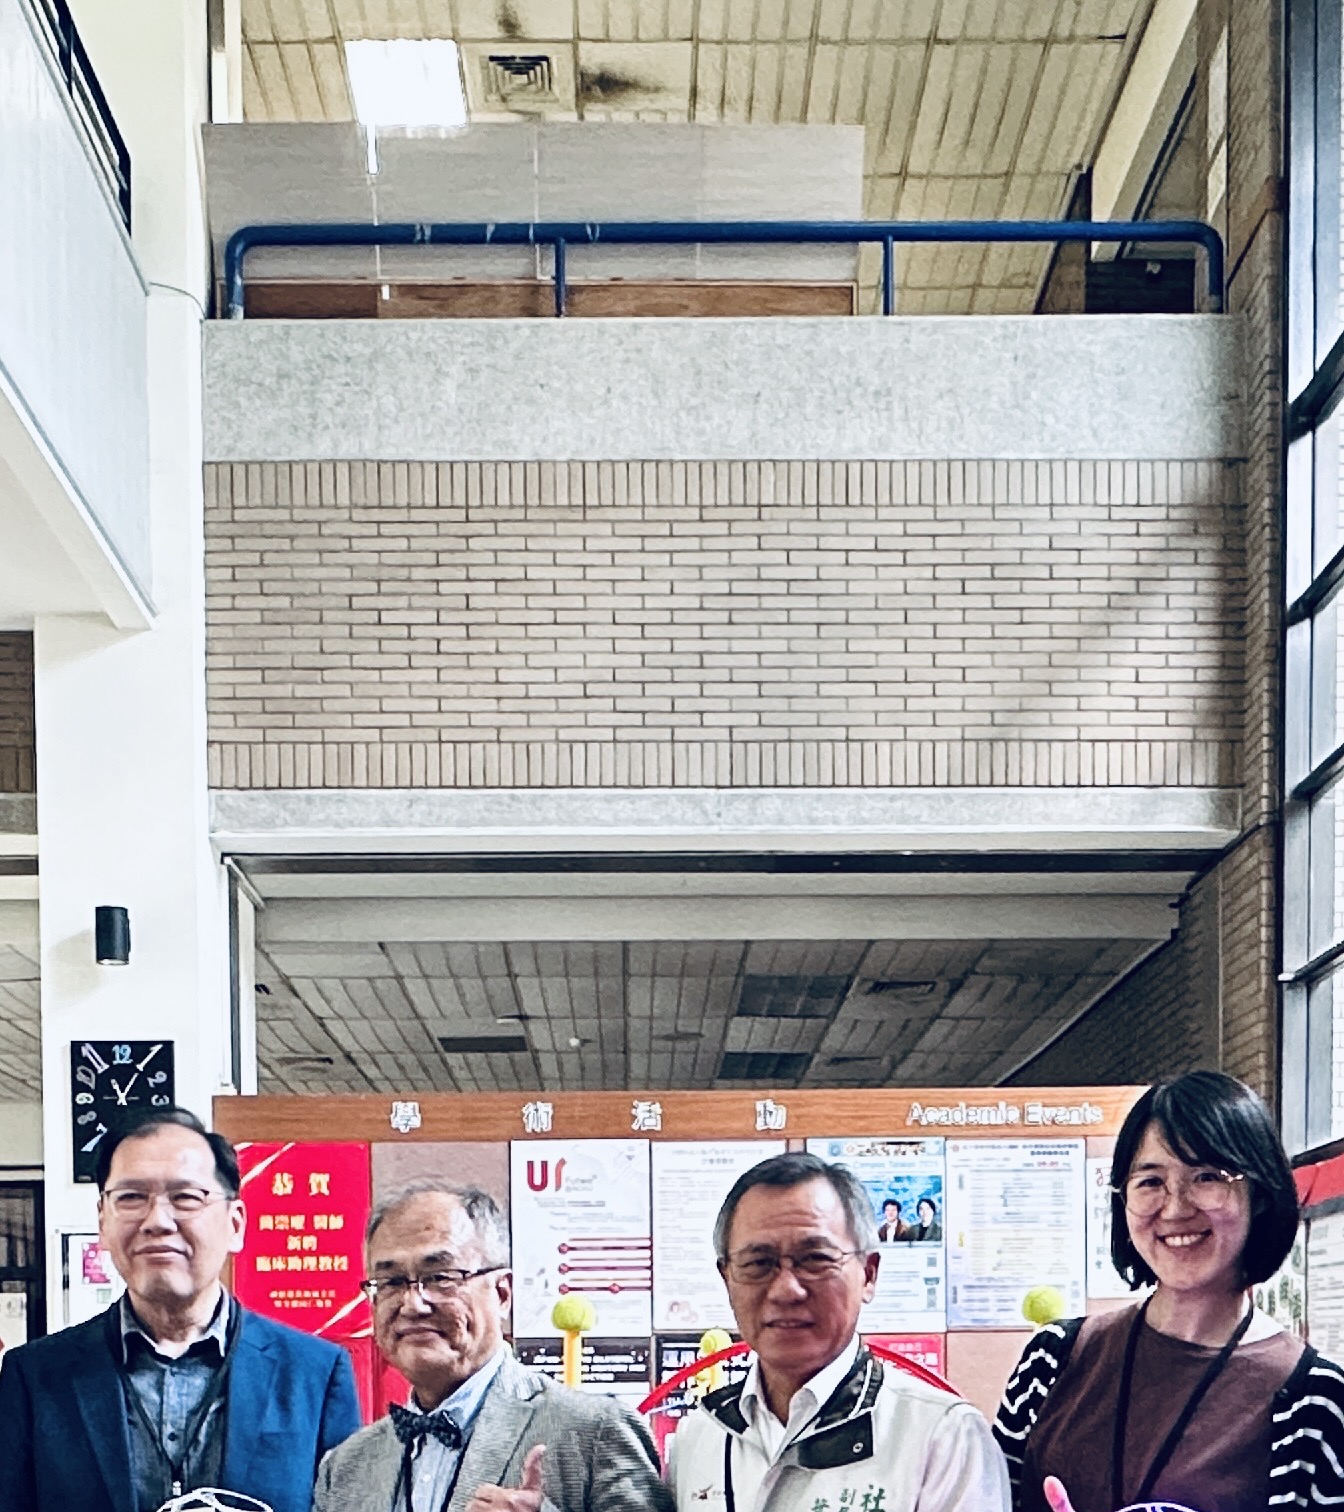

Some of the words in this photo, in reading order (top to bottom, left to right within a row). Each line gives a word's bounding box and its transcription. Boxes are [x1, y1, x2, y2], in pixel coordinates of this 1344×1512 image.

[81, 1043, 110, 1074] 11
[112, 1044, 133, 1065] 12
[136, 1044, 163, 1071] 1
[147, 1071, 167, 1088] 2
[151, 1094, 170, 1106] 3
[77, 1111, 97, 1125] 8
[905, 1101, 1020, 1126] Academic
[1023, 1101, 1104, 1126] Events
[80, 1122, 108, 1152] 7
